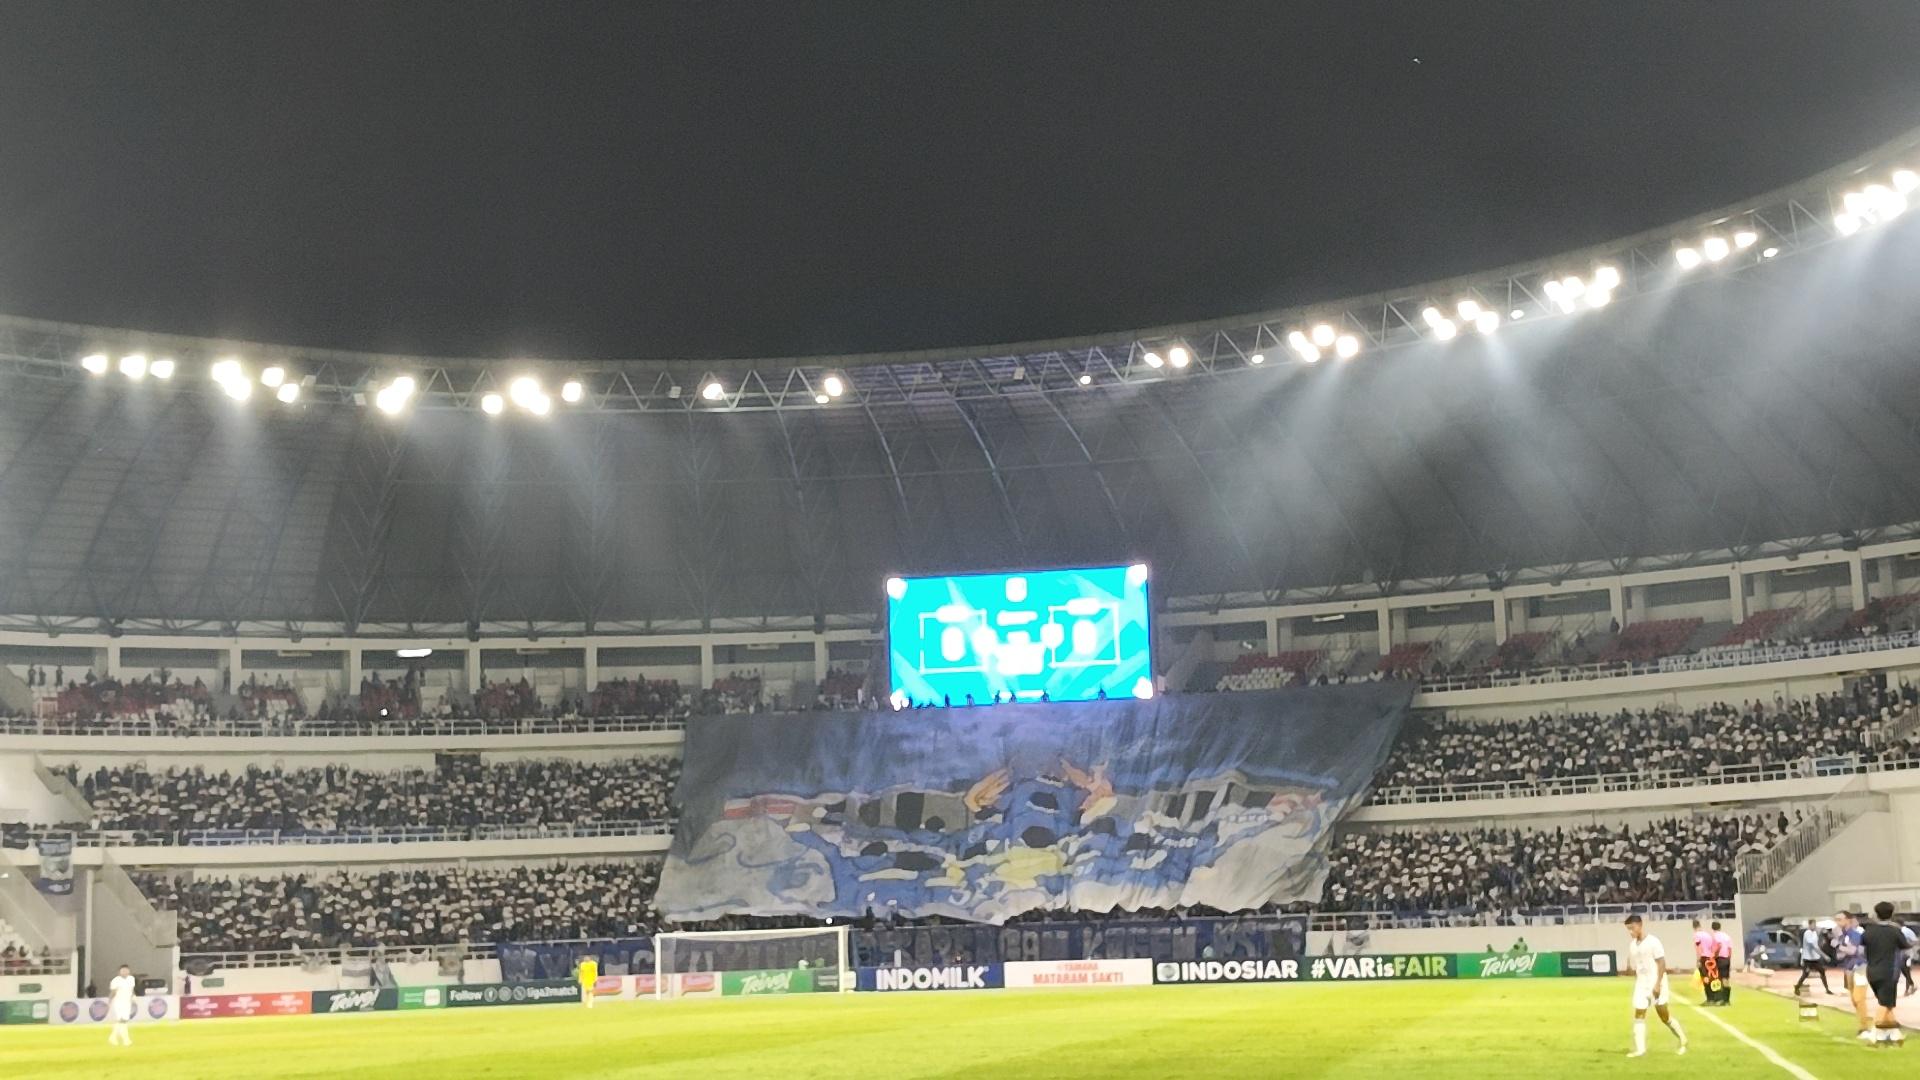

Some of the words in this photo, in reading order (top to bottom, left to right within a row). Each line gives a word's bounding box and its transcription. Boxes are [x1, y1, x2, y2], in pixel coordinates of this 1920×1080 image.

[876, 966, 985, 989] INDOMILK
[1033, 972, 1088, 984] MATARAM
[1092, 971, 1124, 983] SAKTI
[1182, 960, 1298, 981] INDOSIAR
[1311, 956, 1448, 979] #VARisFAIR
[450, 990, 483, 1001] Follow
